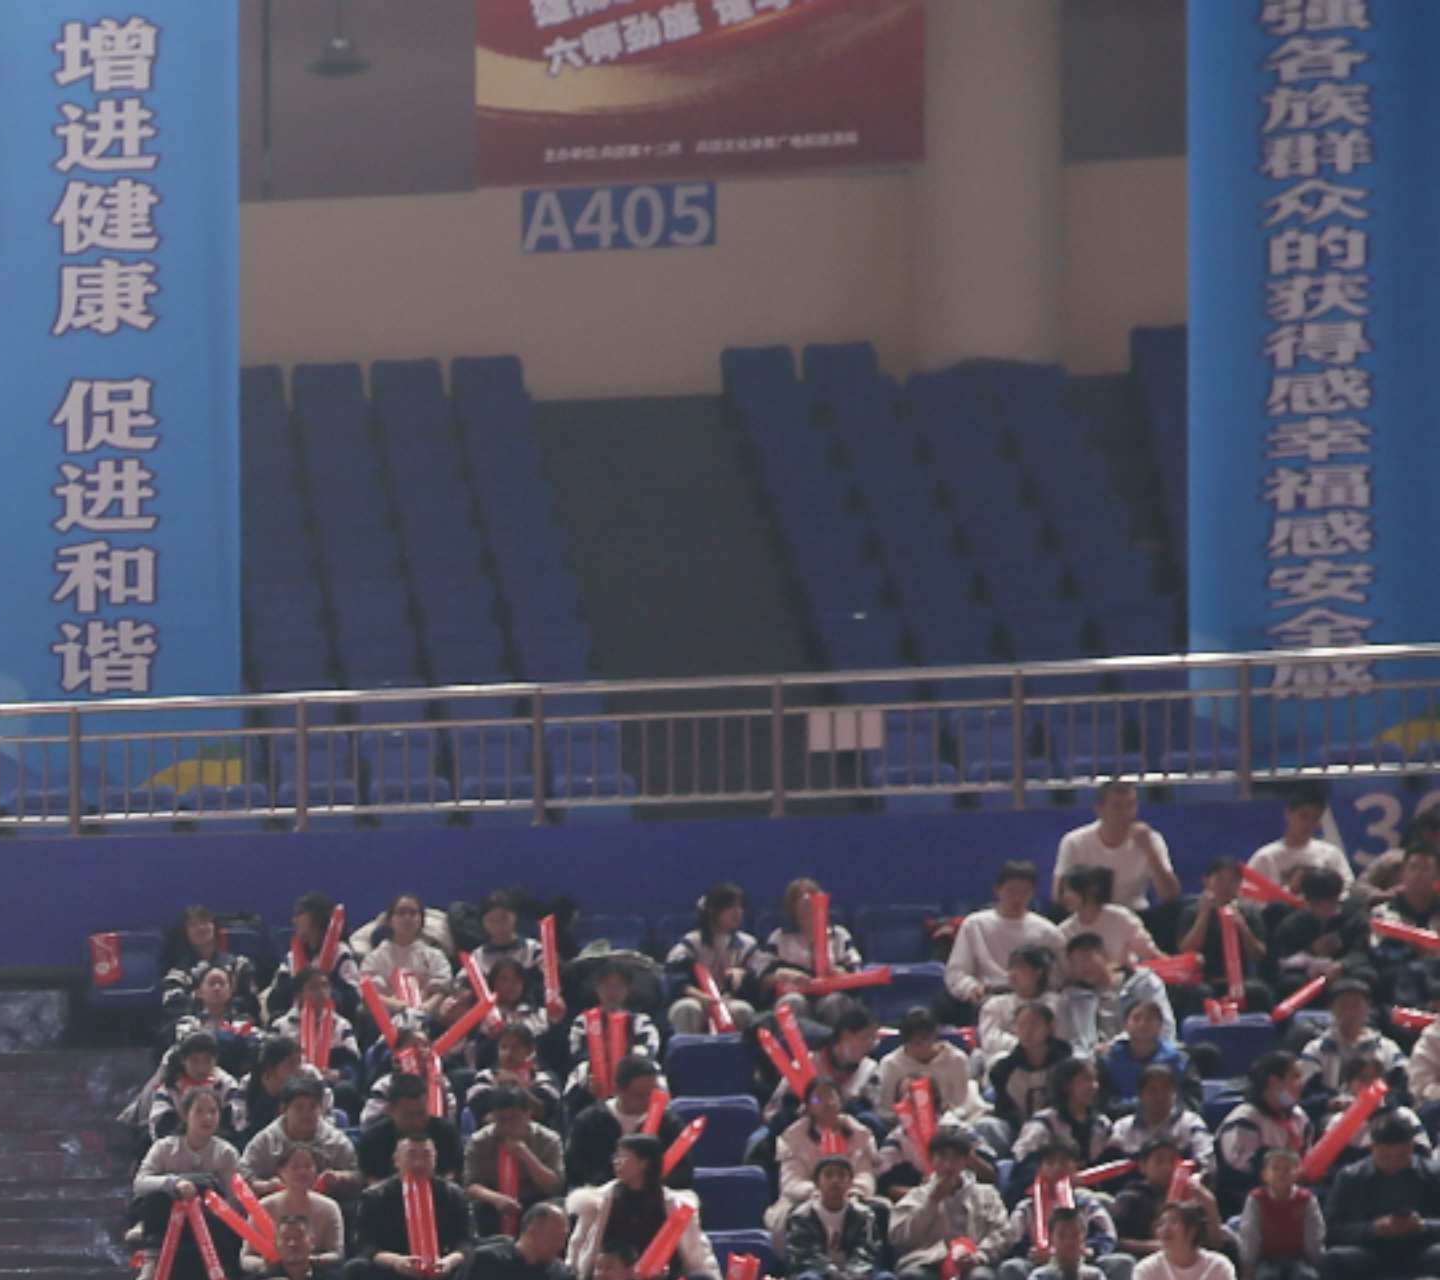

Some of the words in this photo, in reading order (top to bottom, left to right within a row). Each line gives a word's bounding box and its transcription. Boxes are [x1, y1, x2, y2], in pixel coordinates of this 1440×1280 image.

[50, 19, 160, 338] 增进健康
[523, 186, 712, 252] A405
[50, 377, 159, 696] 促进和谐
